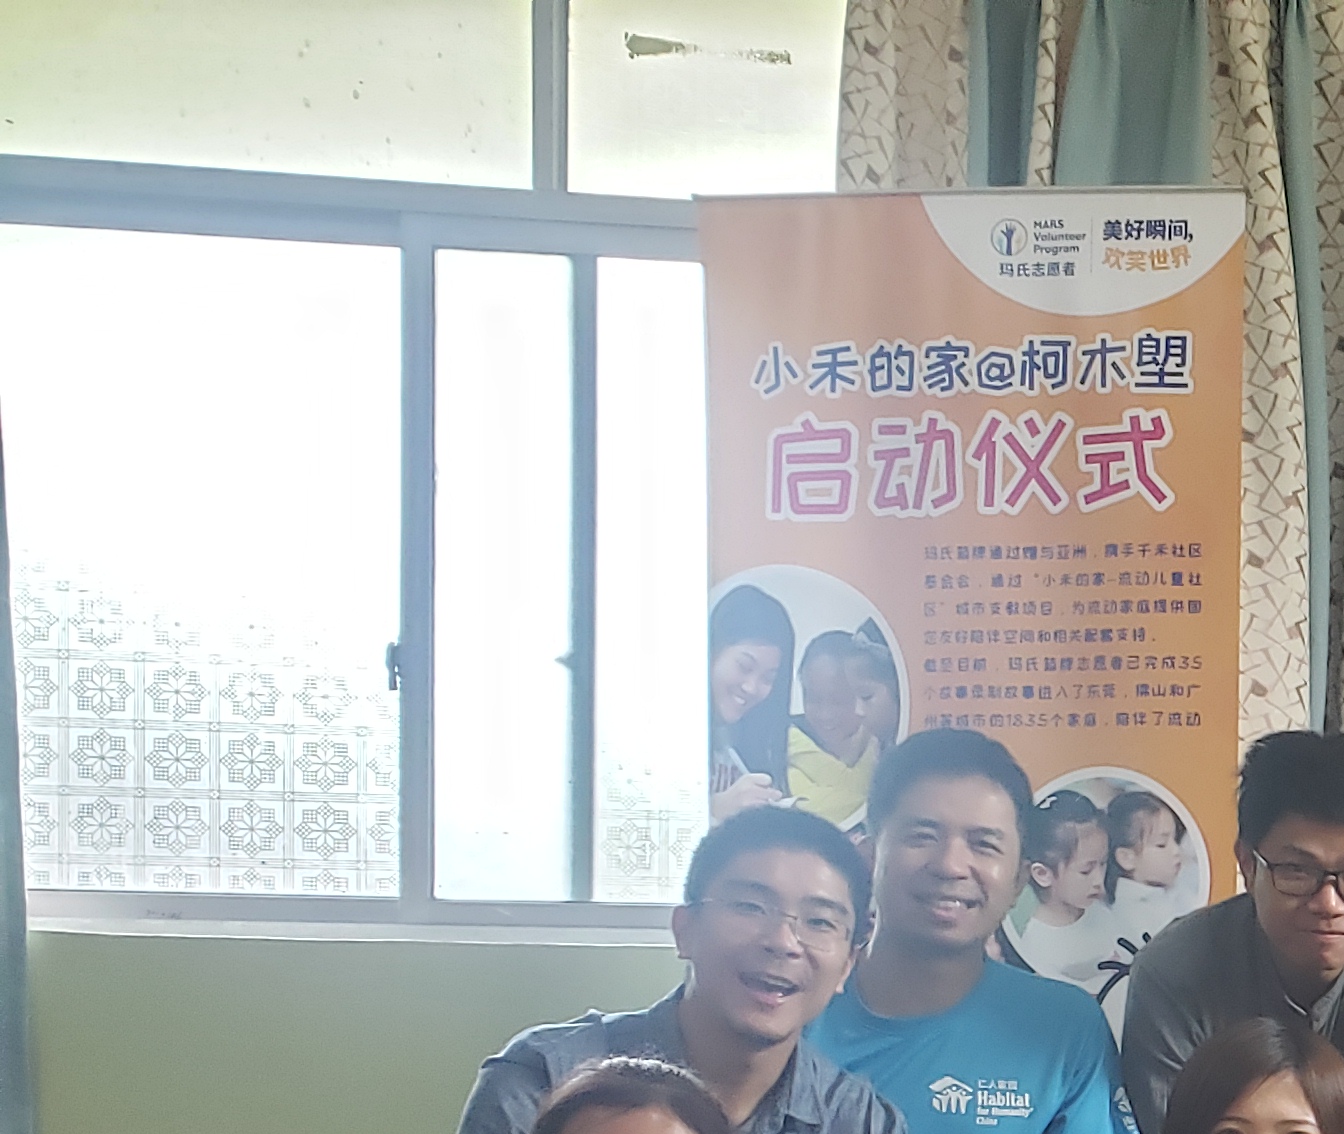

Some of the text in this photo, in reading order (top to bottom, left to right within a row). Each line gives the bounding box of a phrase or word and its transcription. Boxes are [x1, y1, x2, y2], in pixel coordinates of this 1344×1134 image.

[1033, 219, 1064, 229] MARS
[1033, 232, 1087, 242] Volunteer
[1033, 244, 1079, 255] Program
[1102, 244, 1192, 272] 欢笑世界
[999, 262, 1076, 277] 玛氏志愿者
[755, 334, 1189, 395] 小禾的家@柯木塱
[771, 416, 1168, 514] 启动仪式
[977, 1090, 1030, 1107] Habitat
